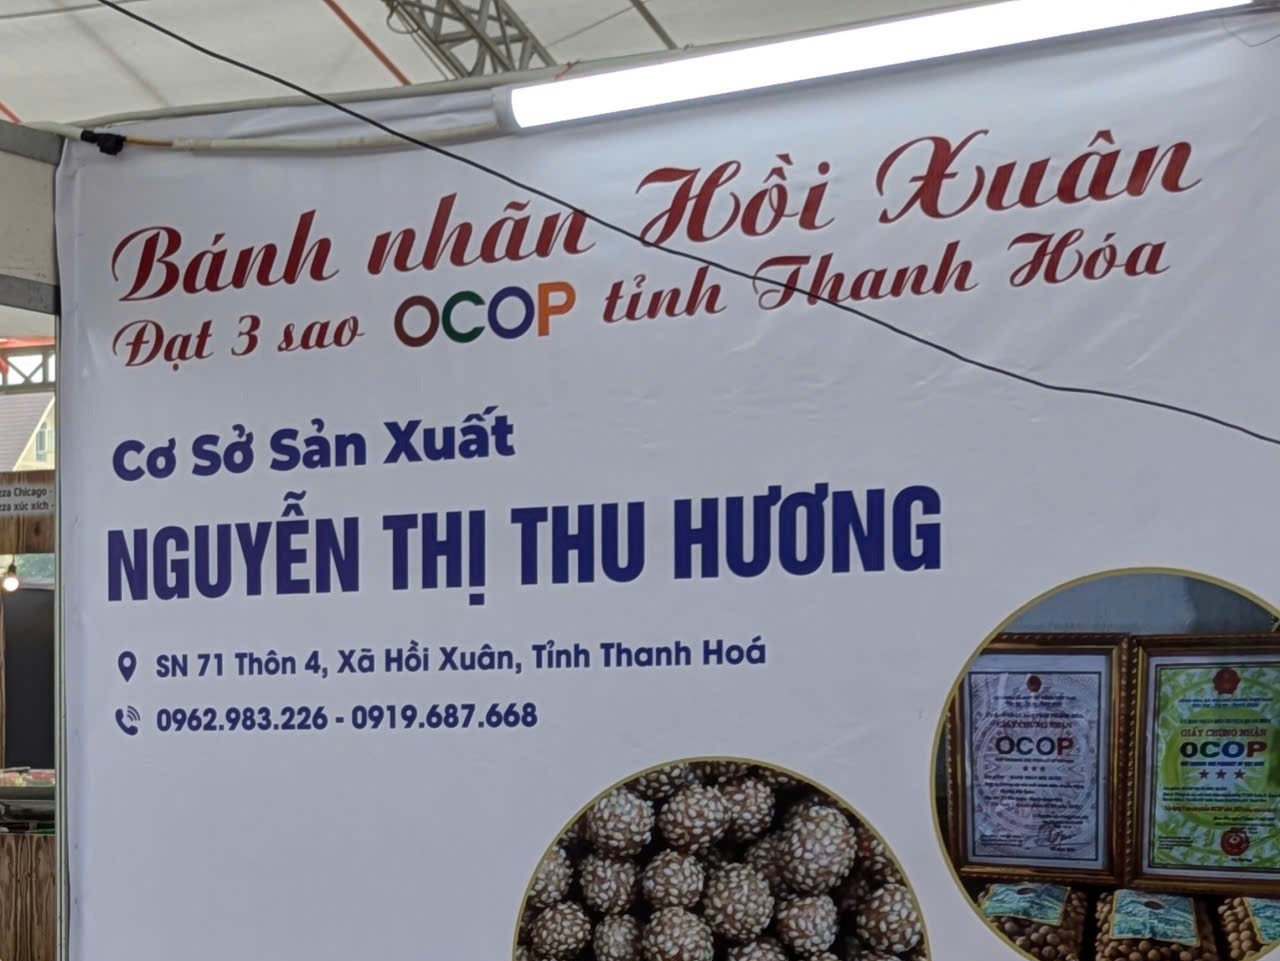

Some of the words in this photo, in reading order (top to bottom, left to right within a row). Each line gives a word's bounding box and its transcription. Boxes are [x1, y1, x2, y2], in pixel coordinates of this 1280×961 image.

[111, 209, 339, 301] Bánh
[367, 192, 596, 276] nhãn
[636, 154, 836, 248] Hồi
[875, 129, 1203, 225] Xuân
[113, 319, 214, 371] Đạt
[231, 315, 261, 356] 3
[277, 316, 364, 352] sao
[394, 281, 576, 347] OCOP
[602, 265, 728, 323] tỉnh
[752, 240, 978, 310] Thanh
[1007, 229, 1171, 287] Hóa
[112, 438, 177, 481] Cơ
[192, 424, 254, 476] Sở
[270, 418, 366, 471] Sản
[383, 406, 516, 463] Xuất
[13, 487, 48, 498] Chicago
[107, 491, 359, 602] NGUYỄN
[383, 510, 485, 605] THỊ
[511, 501, 645, 586] THU
[674, 482, 941, 579] HƯƠNG
[156, 653, 188, 678] SN
[198, 653, 223, 677] 71
[235, 650, 296, 676] Thôn
[304, 650, 328, 679] 4,
[337, 647, 374, 673] Xã
[385, 640, 429, 672] Hồi
[438, 644, 522, 675] Xuân,
[532, 640, 590, 669] Tỉnh
[600, 641, 691, 667] Thanh
[703, 635, 766, 665] Hoá
[156, 706, 328, 731] 0962.983.226
[351, 702, 538, 729] 0919.687.668
[995, 736, 1073, 755] OCOP
[1180, 741, 1267, 758] OCOP
